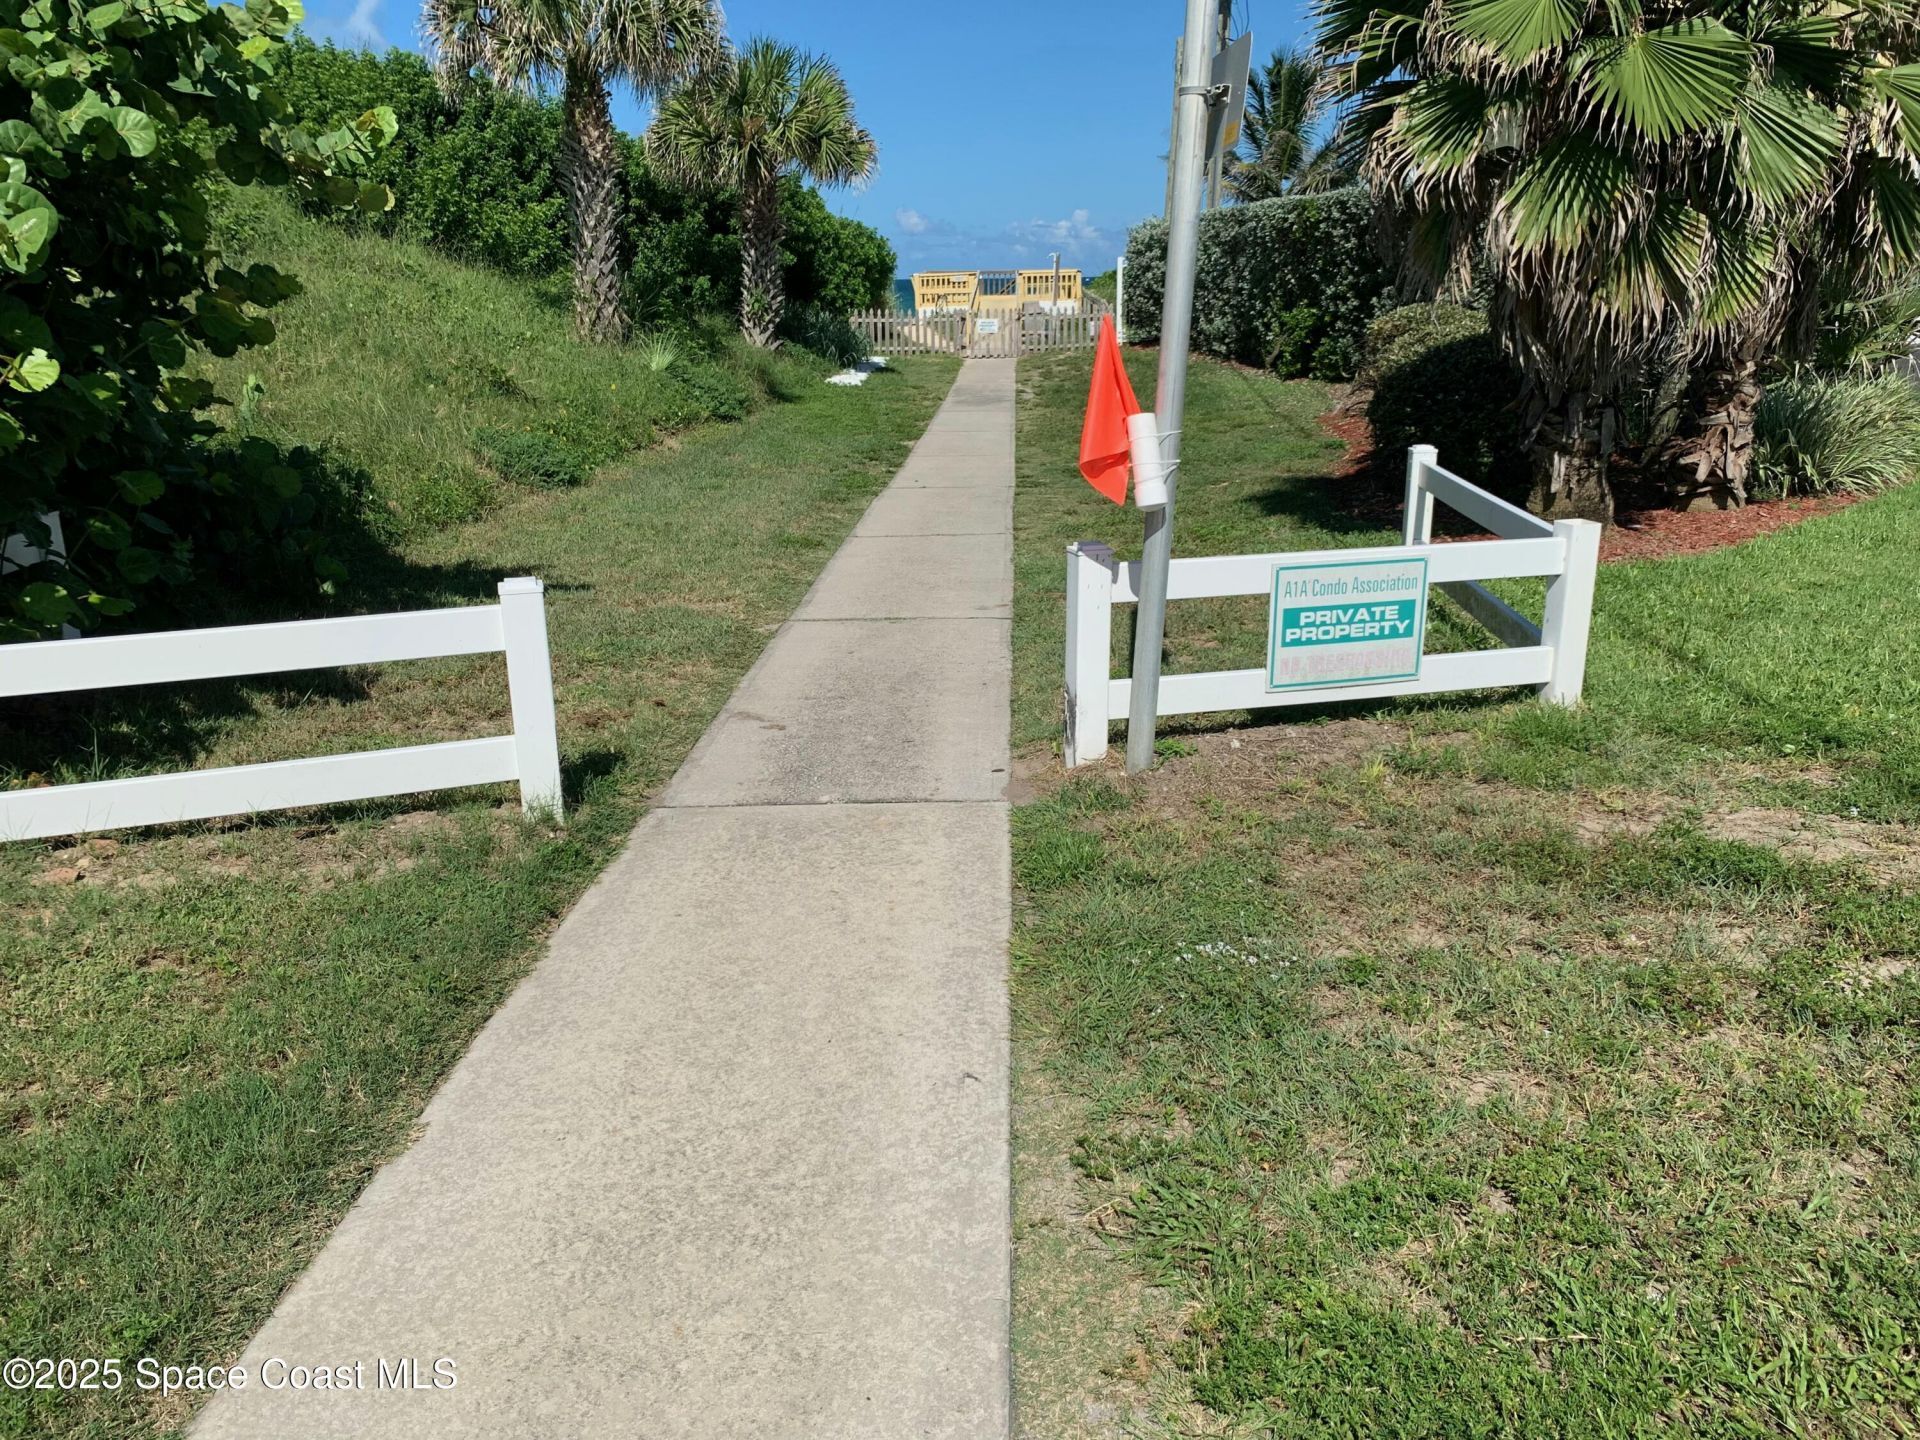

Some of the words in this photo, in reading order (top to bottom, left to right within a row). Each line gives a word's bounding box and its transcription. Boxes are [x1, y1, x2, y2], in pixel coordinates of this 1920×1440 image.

[1284, 580, 1308, 598] A1A
[1312, 578, 1347, 597] Condo
[1352, 574, 1418, 594] Association
[1300, 605, 1399, 626] PRIVATE
[1285, 619, 1410, 642] PROPERTY
